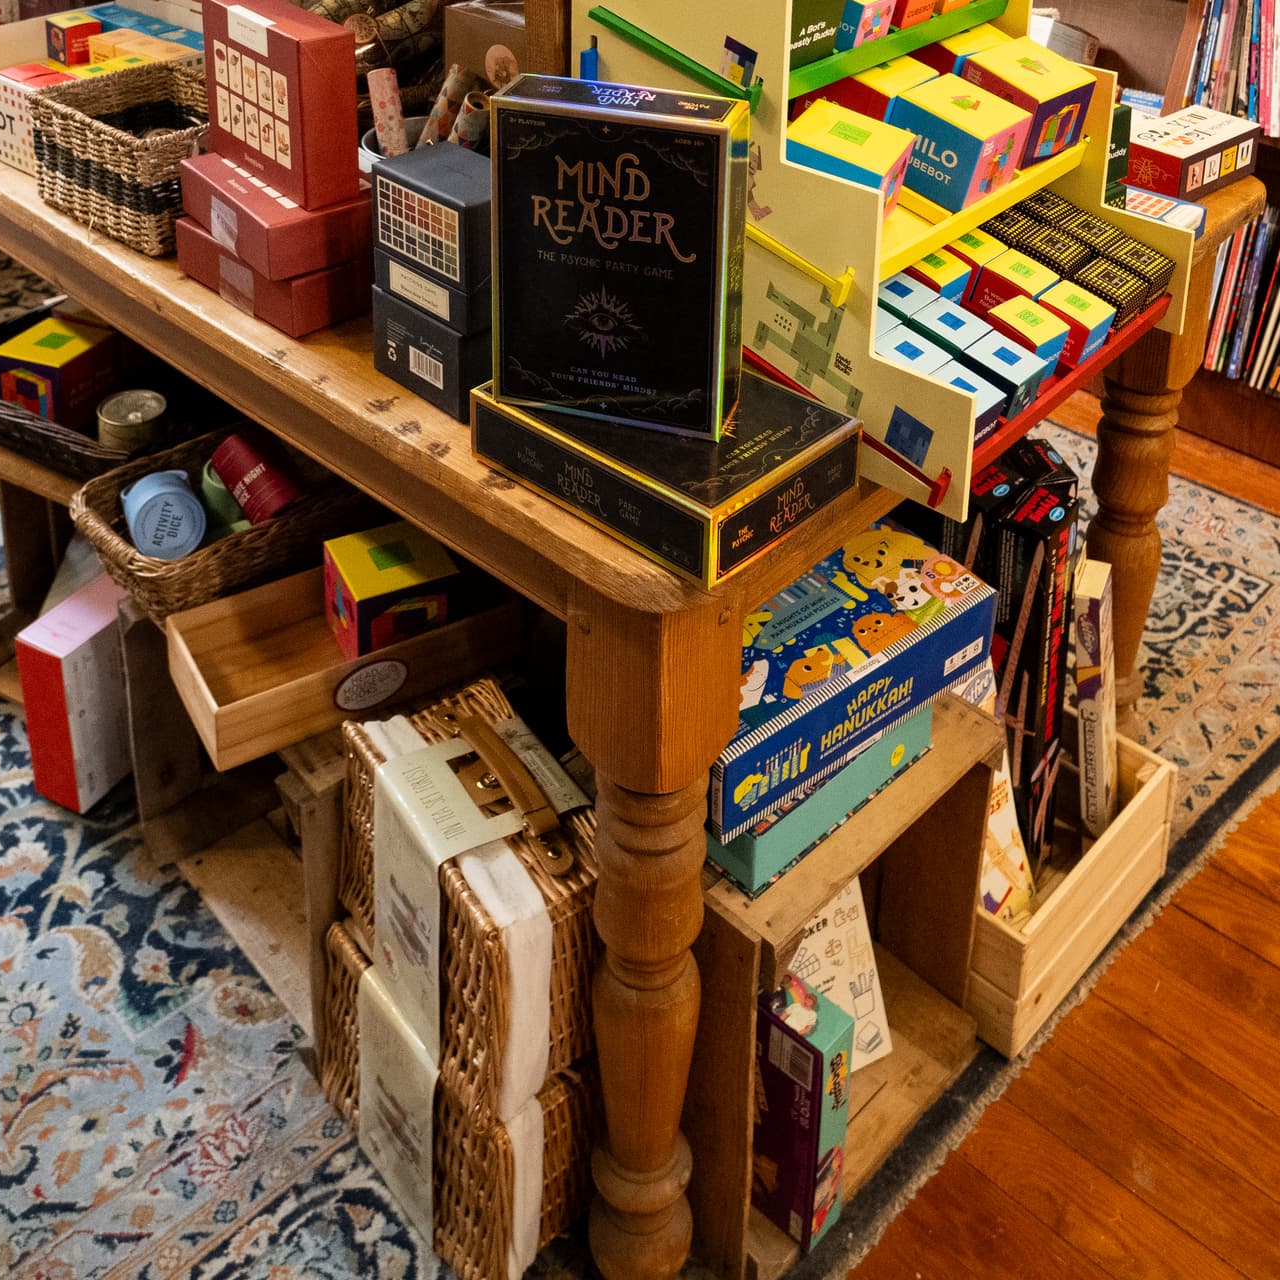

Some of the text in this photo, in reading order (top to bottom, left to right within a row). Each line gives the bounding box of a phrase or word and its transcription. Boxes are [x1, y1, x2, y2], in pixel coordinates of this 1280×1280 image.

[907, 2, 934, 18] CUBEBOT
[799, 20, 826, 37] A Bot's
[812, 26, 836, 46] Buddy
[904, 127, 959, 169] MILO
[555, 153, 651, 208] MIND
[907, 154, 952, 186] UBEBOT
[531, 195, 696, 263] READER
[537, 250, 673, 280] THE PSYCHIC PARTY GAME
[551, 372, 657, 395] YOUR FRIENDS' MINDS?
[570, 366, 637, 384] CAN YOU READ
[725, 429, 773, 460] CAN YOU READ
[243, 462, 267, 489] NIGHT
[563, 460, 593, 488] MIND
[557, 473, 608, 517] READER
[618, 498, 642, 516] PARTY
[777, 477, 805, 510] MIND
[152, 500, 173, 547] ACTIVITY
[170, 514, 184, 538] DICE
[619, 507, 641, 527] GAME
[769, 491, 816, 532] READER
[731, 528, 754, 549] PSYCHIC
[738, 525, 749, 538] THE
[776, 596, 826, 628] NIGHTS OF MINI
[813, 596, 841, 618] PUZZLES
[846, 675, 894, 716] HAPPY
[820, 677, 914, 751] HANUKKAH!
